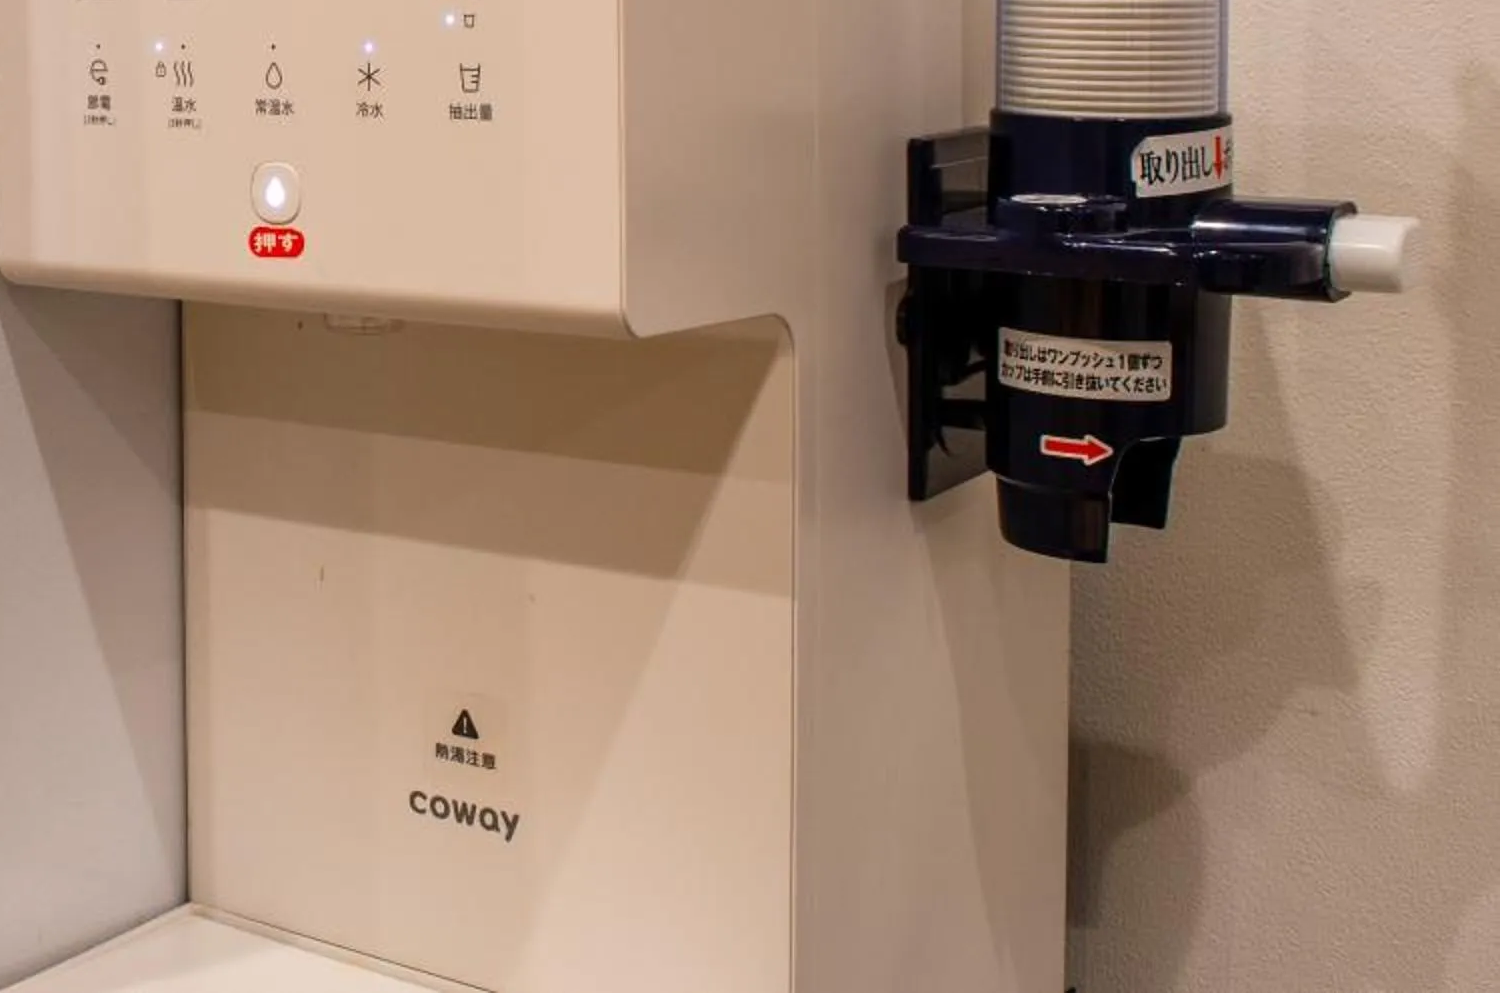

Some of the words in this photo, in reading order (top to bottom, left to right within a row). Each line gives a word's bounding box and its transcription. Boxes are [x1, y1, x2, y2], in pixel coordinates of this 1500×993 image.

[172, 96, 197, 113] 温水
[255, 98, 295, 116] 常温水
[356, 102, 383, 119] 冷水
[449, 103, 493, 121] 抽出量
[253, 232, 299, 253] 押す
[409, 790, 520, 843] coway
